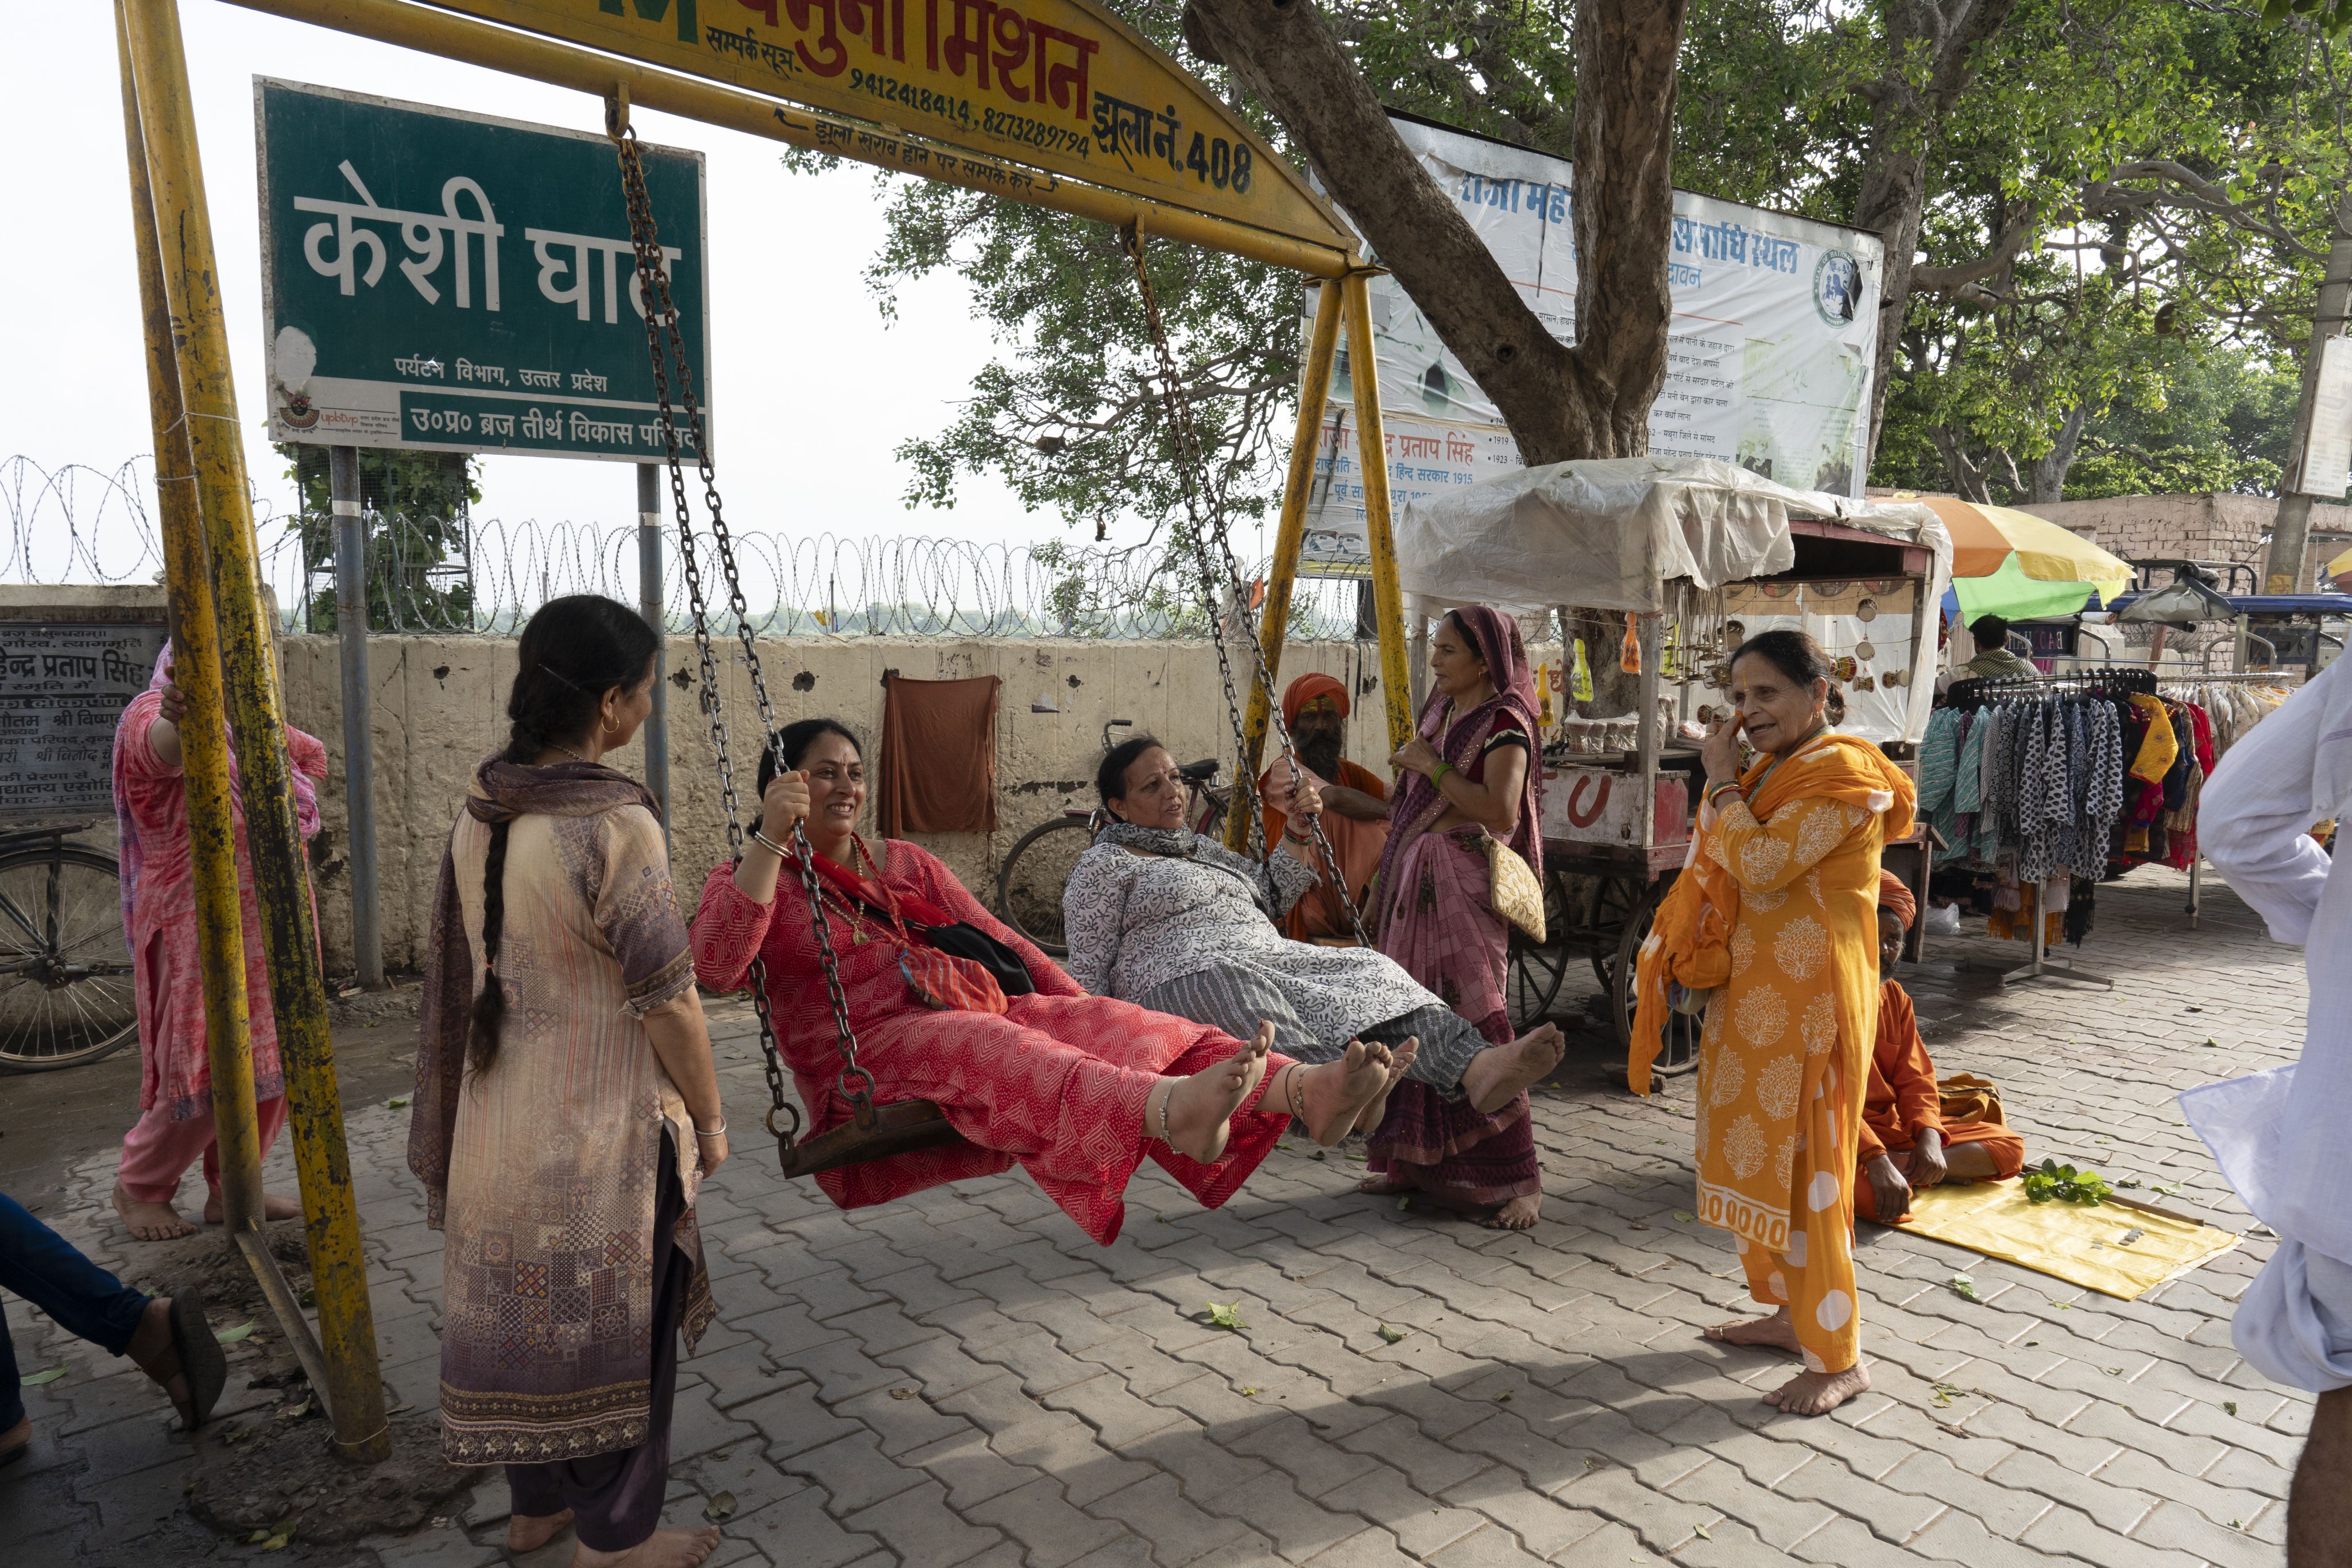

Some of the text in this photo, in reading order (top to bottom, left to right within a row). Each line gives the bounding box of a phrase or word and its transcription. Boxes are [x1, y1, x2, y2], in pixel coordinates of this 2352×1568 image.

[706, 25, 758, 61] सम्पर्क
[1092, 90, 1154, 172] झूला
[1186, 130, 1252, 193] 408
[933, 150, 958, 177] पर
[294, 159, 504, 311] केशी
[394, 353, 444, 380] पर्यटन
[519, 369, 560, 389] उत्तर
[571, 369, 608, 392] प्रदेश
[479, 412, 514, 437] ब्रज
[520, 407, 563, 440] तीर्थ
[569, 411, 633, 446] विकास
[1399, 435, 1441, 459] प्रताप
[1446, 431, 1475, 467] सिंह
[1493, 436, 1508, 446] 1919
[1492, 455, 1508, 464] 1923
[1396, 462, 1414, 481] हिन्द
[1417, 468, 1450, 483] सरकार
[1452, 472, 1473, 485] 1915
[1334, 479, 1348, 502] पूर्व
[41, 654, 98, 679] प्रताप
[101, 649, 145, 689] सिंह
[72, 680, 94, 690] में
[53, 709, 74, 726] श्री
[36, 747, 55, 762] श्री
[57, 746, 99, 762] विनोद
[26, 772, 69, 781] प्रेरणा
[73, 769, 88, 779] से
